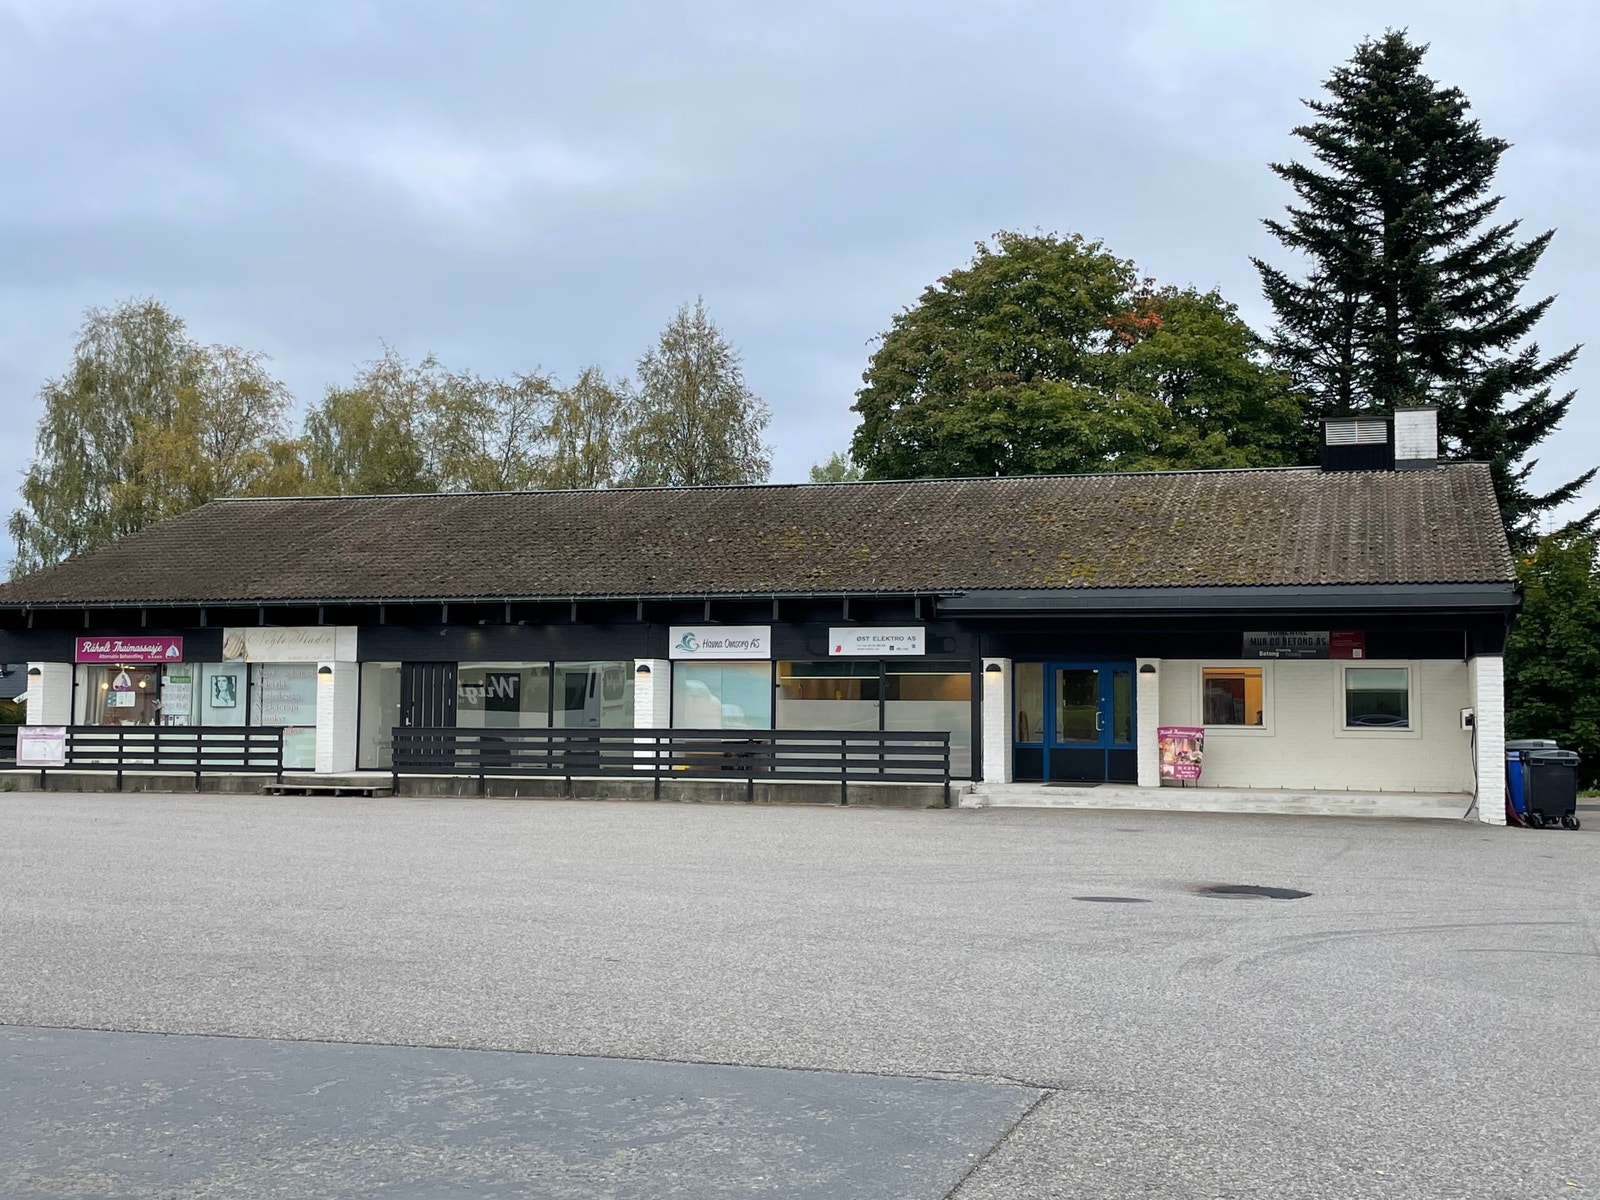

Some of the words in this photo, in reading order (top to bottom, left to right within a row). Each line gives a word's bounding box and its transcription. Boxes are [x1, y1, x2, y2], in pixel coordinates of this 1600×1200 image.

[248, 630, 286, 649] Negle
[289, 630, 332, 645] Studio
[724, 638, 749, 651] Omsorg
[749, 638, 761, 649] AS
[1249, 637, 1268, 646] MUR
[1269, 637, 1281, 646] OG
[1282, 637, 1314, 646] BETONG
[82, 641, 111, 653] Råholt
[112, 641, 163, 655] Thaimassasje
